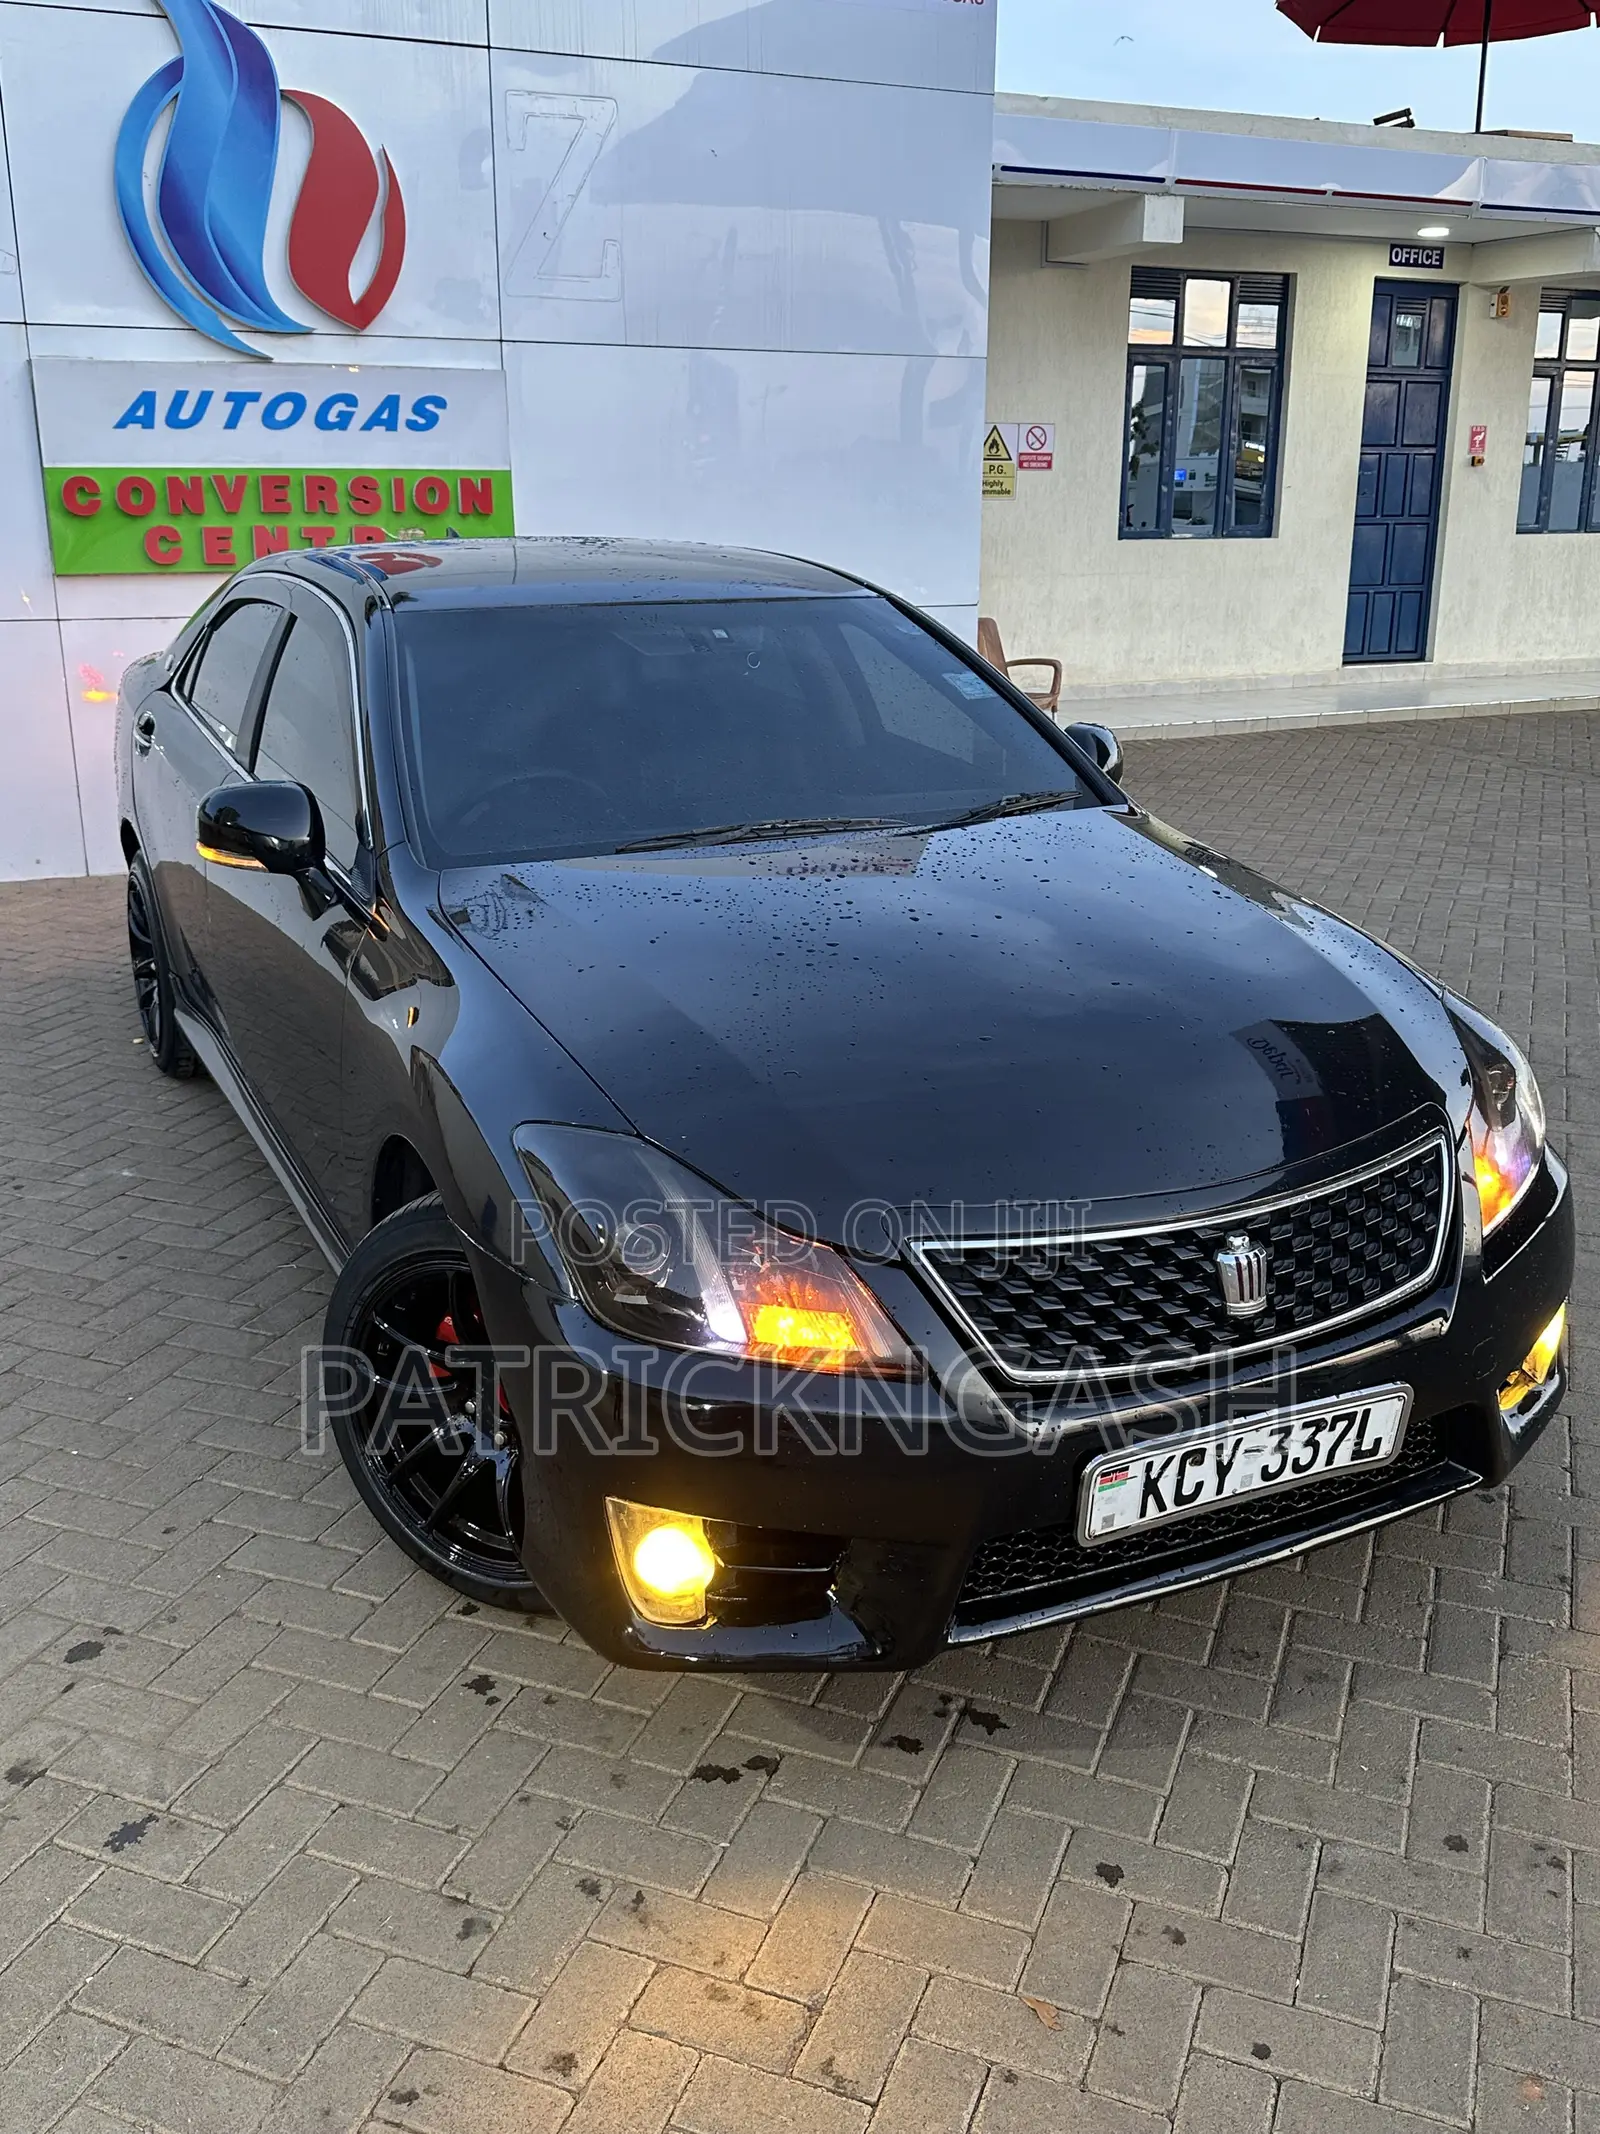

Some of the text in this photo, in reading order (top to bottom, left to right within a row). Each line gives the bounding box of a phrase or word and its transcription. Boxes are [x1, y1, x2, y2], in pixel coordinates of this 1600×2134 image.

[1391, 247, 1441, 265] OFFICE
[113, 389, 447, 432] AUTOGAS
[982, 464, 1007, 475] .P.G.
[62, 475, 494, 516] CONVERSION
[1139, 1437, 1243, 1519] KCY
[1260, 1408, 1384, 1482] 337L
